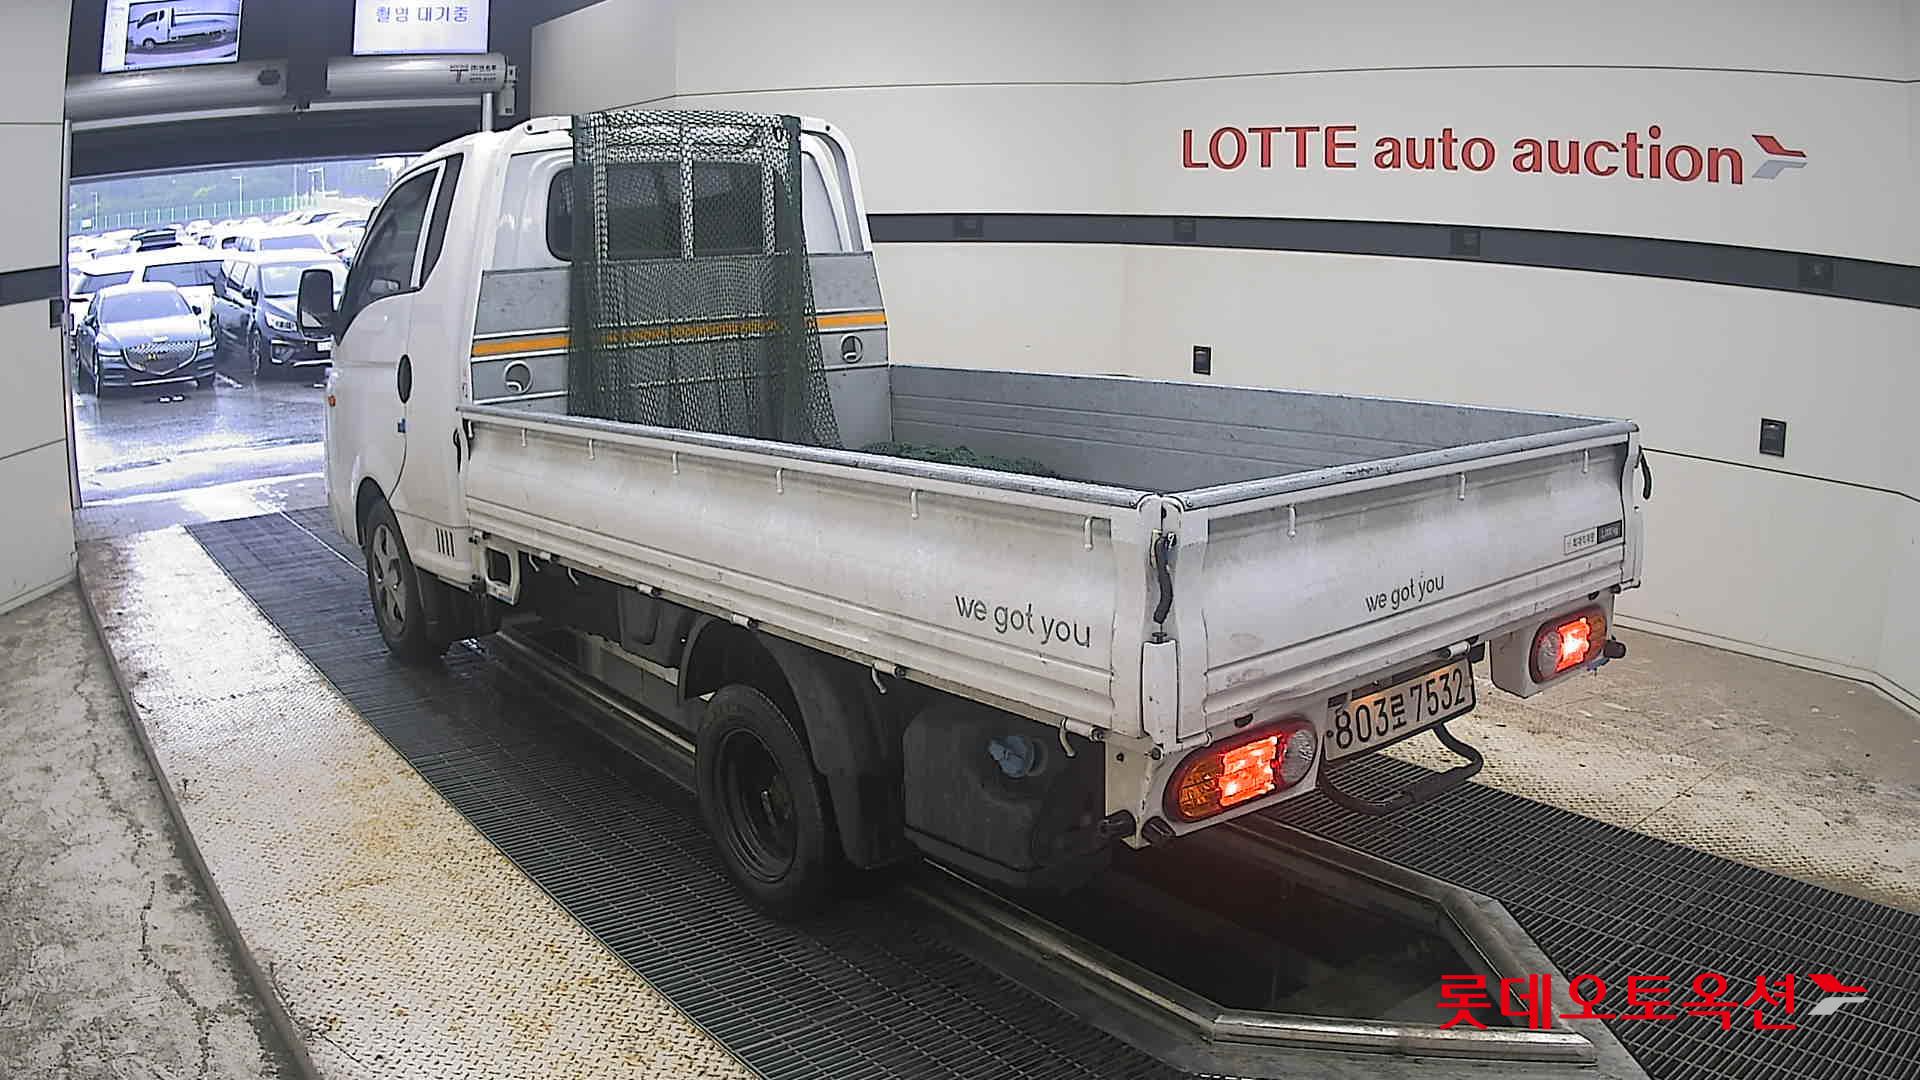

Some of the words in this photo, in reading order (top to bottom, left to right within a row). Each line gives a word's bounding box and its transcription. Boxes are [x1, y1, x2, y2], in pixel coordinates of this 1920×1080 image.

[417, 6, 469, 23] 대기중
[1183, 125, 1356, 170] LOTTE
[1373, 128, 1498, 171] auto
[1512, 125, 1744, 184] auction
[1365, 593, 1387, 613] we
[1391, 577, 1415, 610] got
[1418, 575, 1444, 602] you
[955, 595, 987, 621] we
[994, 603, 1034, 634] got
[1041, 615, 1090, 648] you
